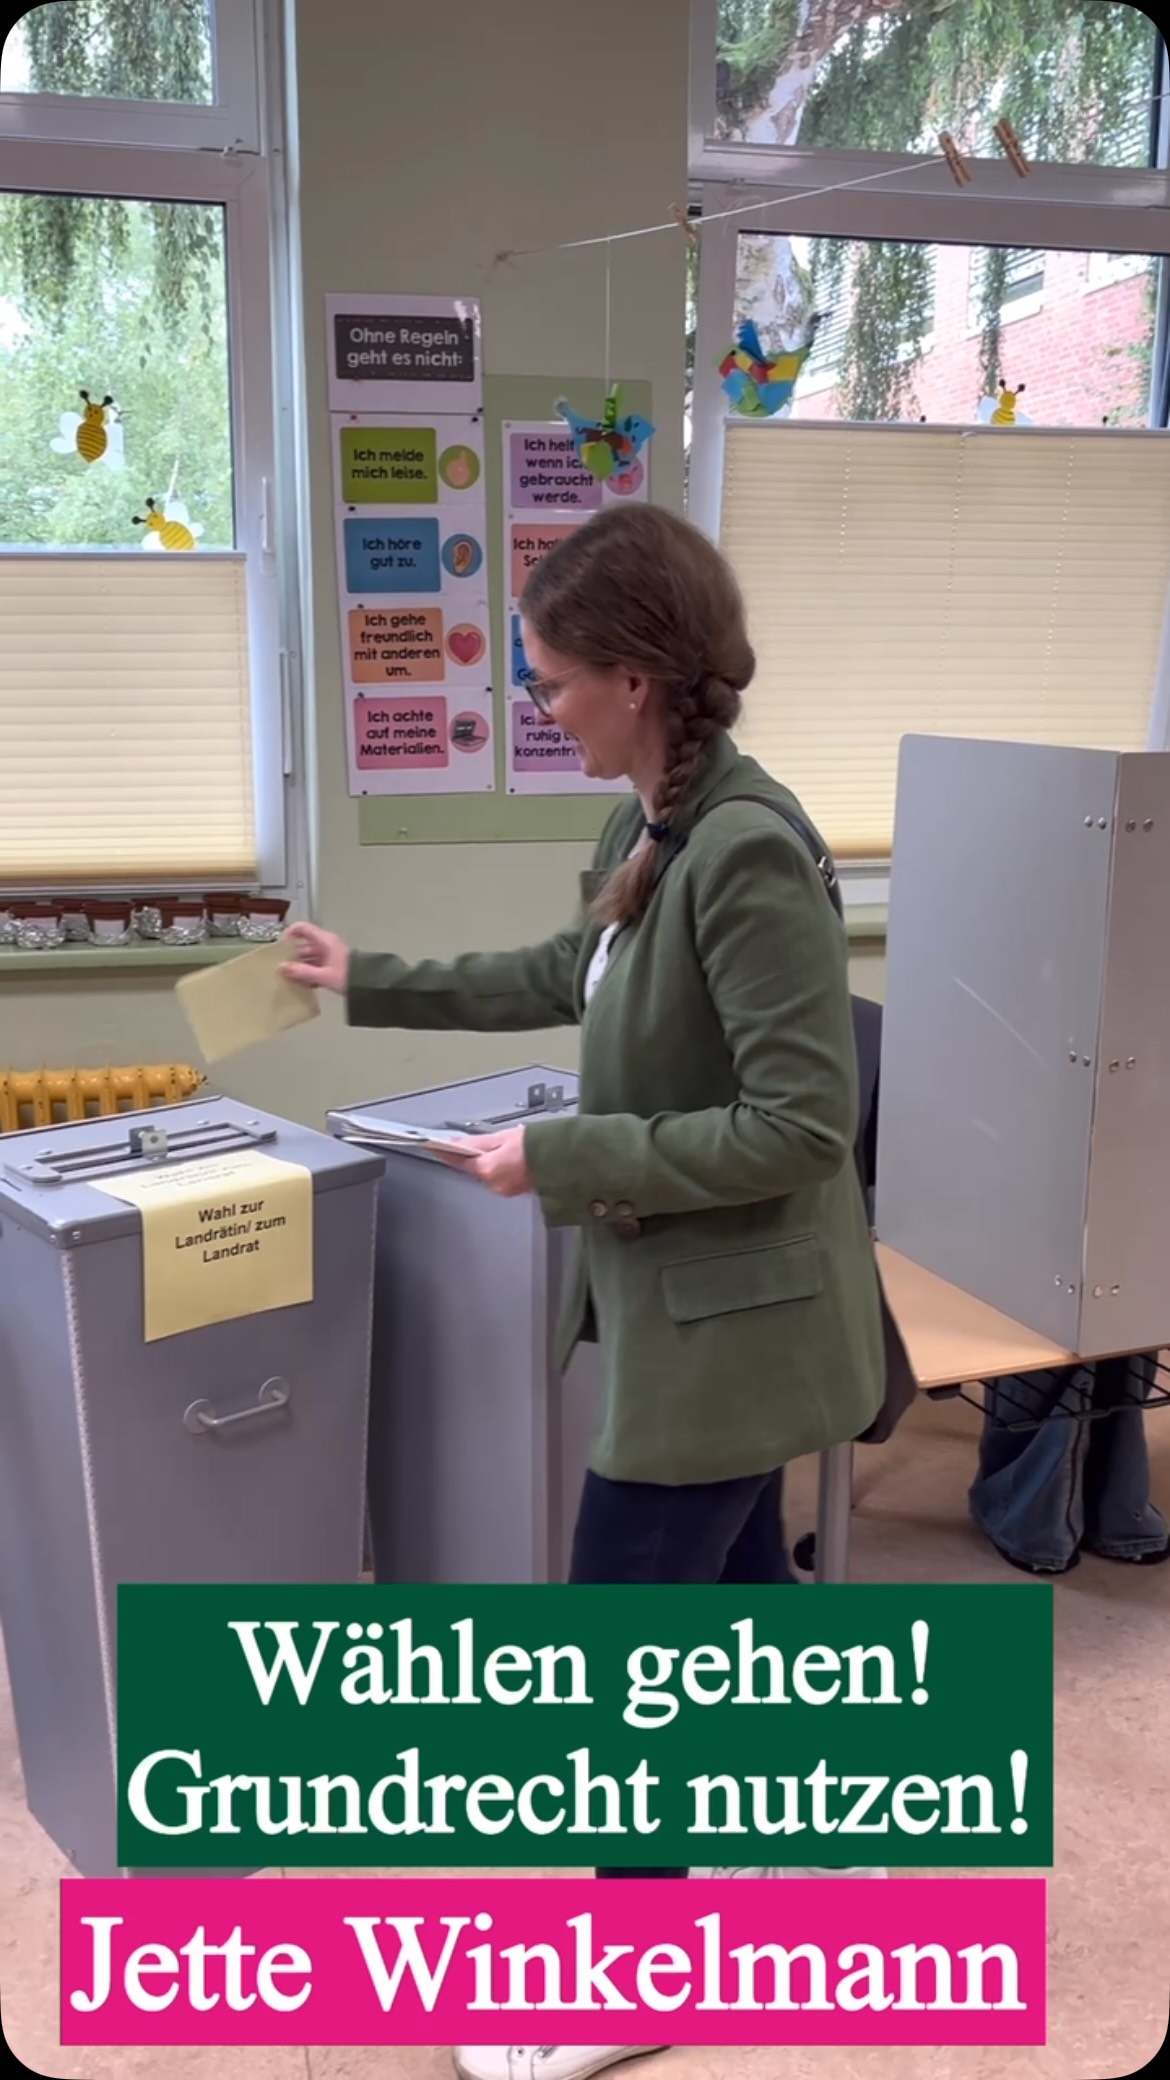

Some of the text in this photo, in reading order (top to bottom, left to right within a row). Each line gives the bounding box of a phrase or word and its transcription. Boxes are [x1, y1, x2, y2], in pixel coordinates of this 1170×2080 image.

[350, 328, 459, 347] Ohne Regeln
[347, 349, 388, 368] geht
[391, 353, 412, 366] es
[524, 438, 546, 452] Ich
[354, 448, 424, 463] Ich melde
[525, 458, 564, 469] wenn
[351, 466, 428, 480] mich leise.
[519, 473, 594, 488] gebraucht
[532, 491, 582, 504] werde.
[362, 537, 422, 552] Ich höre
[513, 538, 536, 551] Ich
[370, 554, 417, 571] gut zu.
[364, 613, 427, 630] Ich gehe
[360, 630, 433, 645] freundlich
[354, 646, 441, 662] mit anderen
[385, 666, 412, 678] um.
[367, 709, 434, 724] Ich achte
[366, 726, 437, 740] auf meine
[526, 730, 561, 744] ruhig
[360, 742, 445, 757] Materialien.
[514, 745, 576, 758] konzentri
[198, 1199, 265, 1223] Wahl zur
[175, 1215, 287, 1249] Landrätin/ zum
[202, 1239, 261, 1264] Landrat
